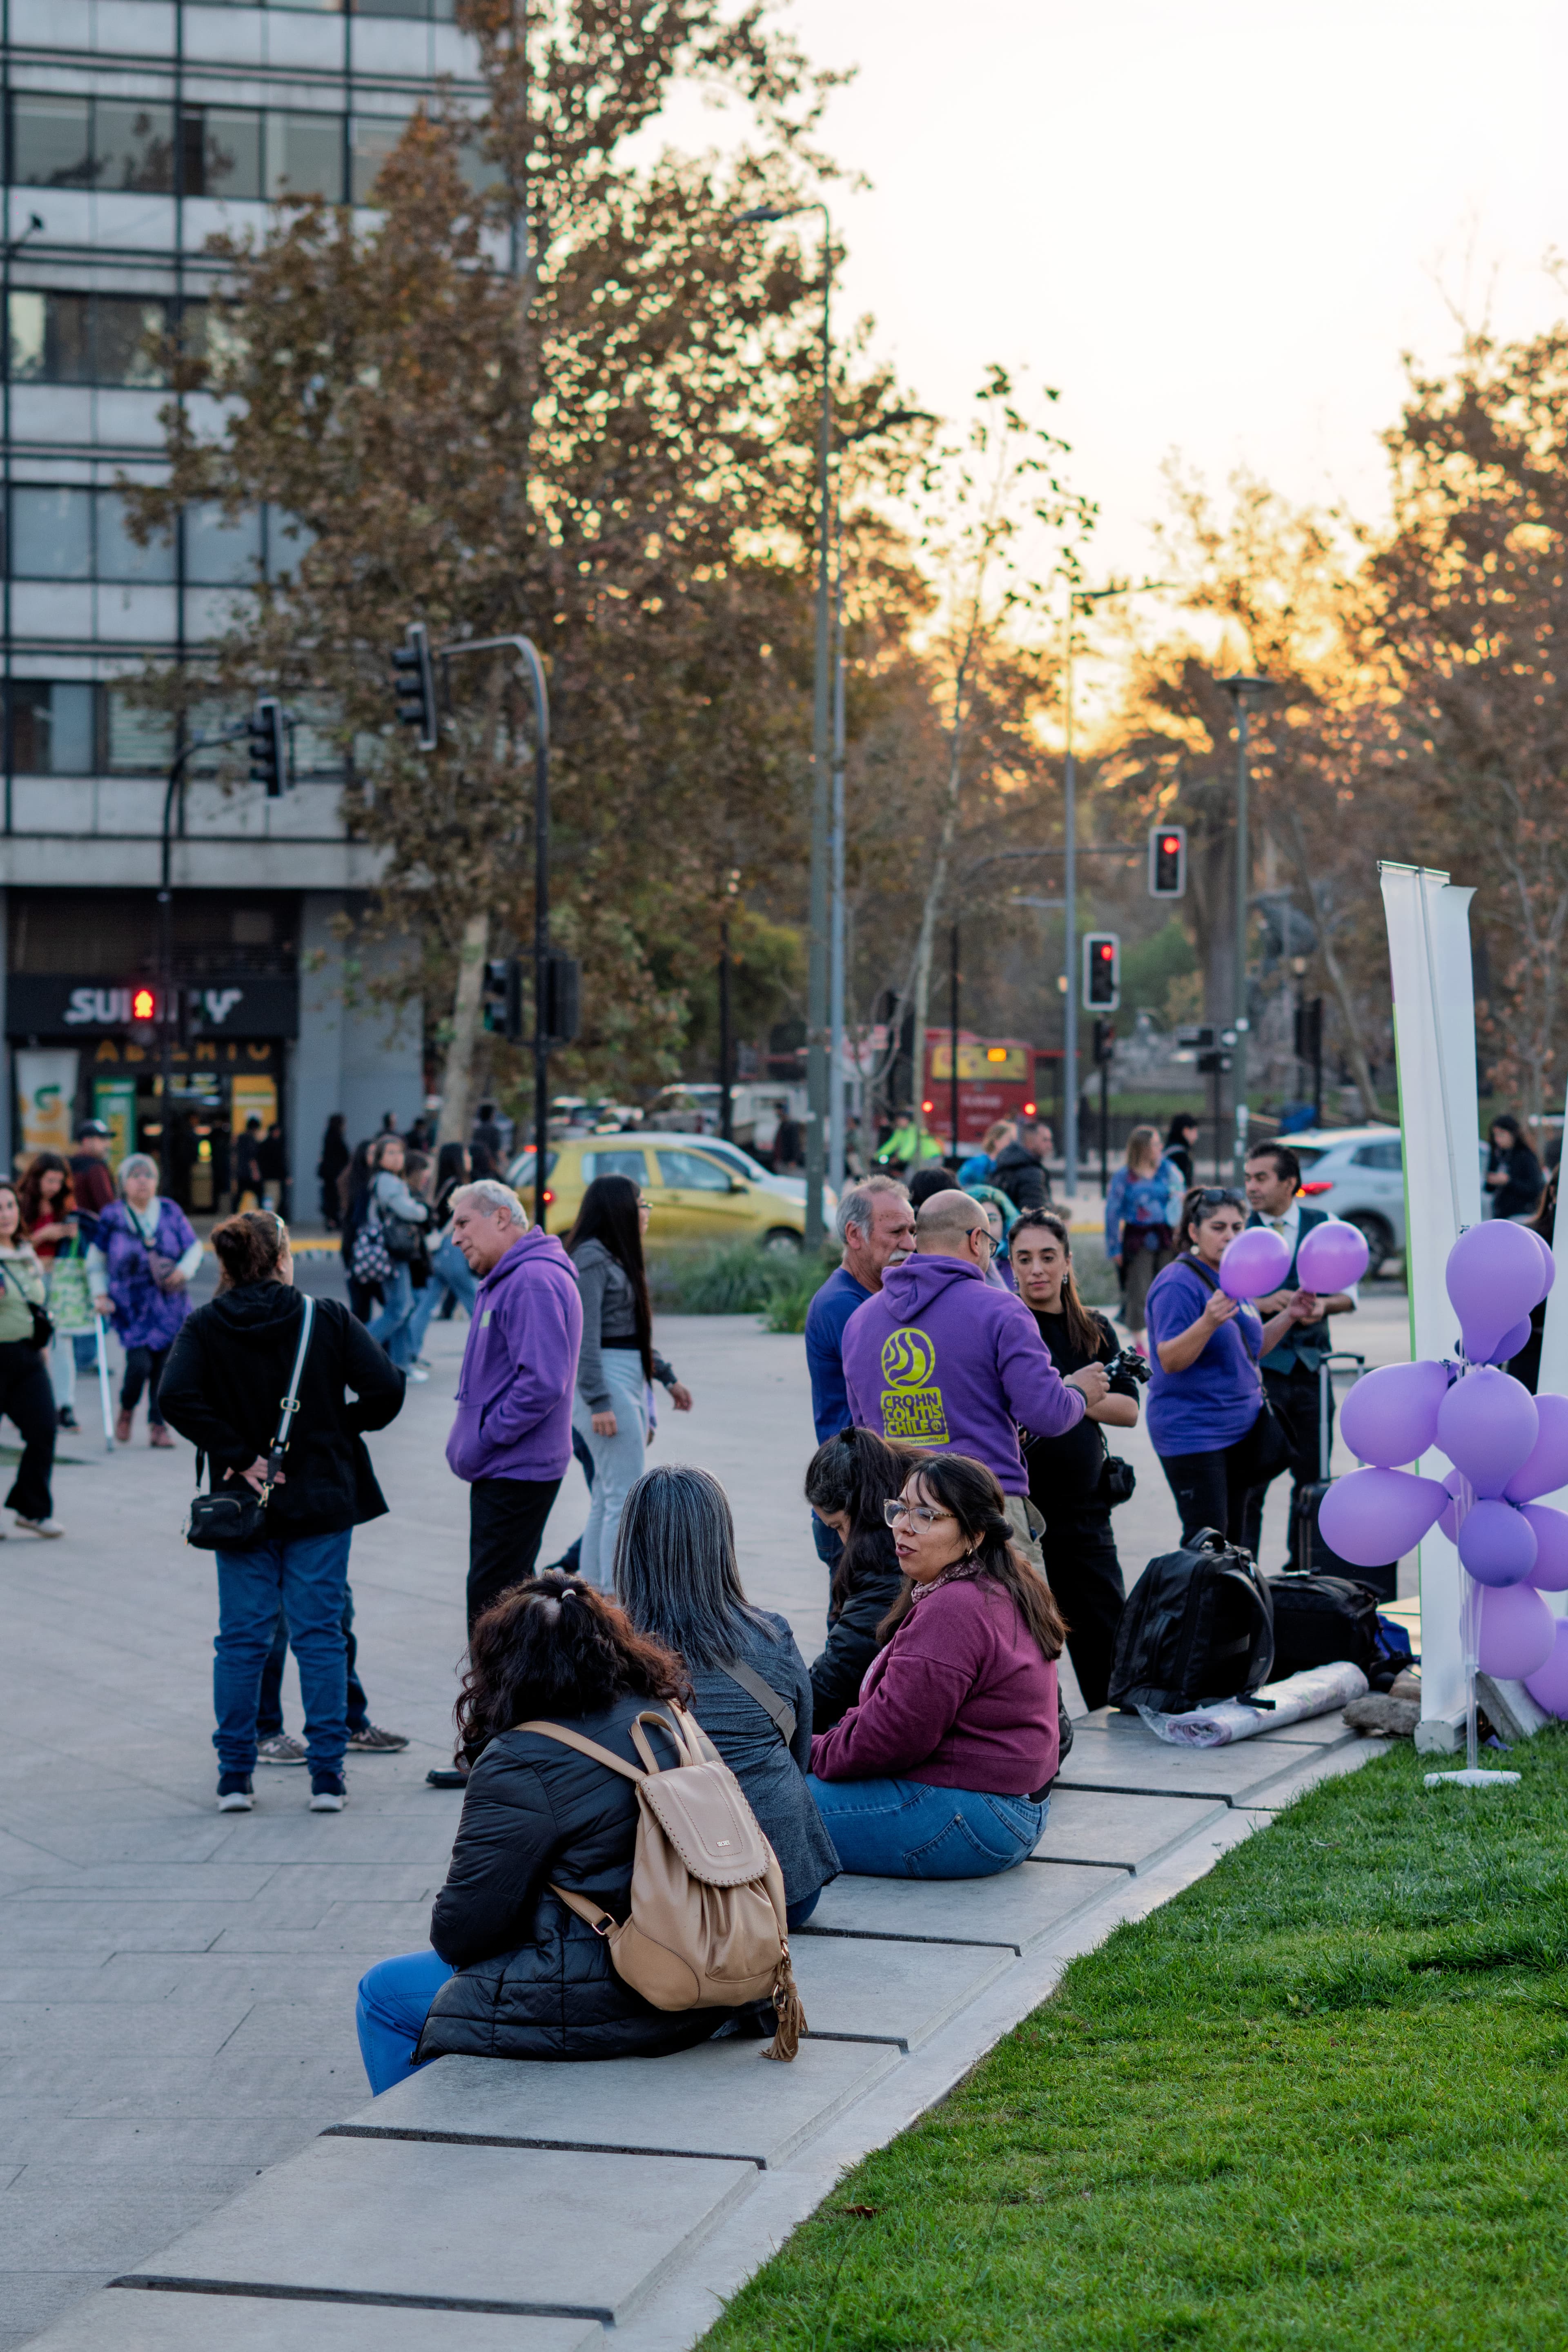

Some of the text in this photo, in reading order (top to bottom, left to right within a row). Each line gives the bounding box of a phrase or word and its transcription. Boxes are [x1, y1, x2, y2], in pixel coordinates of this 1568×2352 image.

[884, 1392, 938, 1410] CROHN
[885, 1405, 942, 1422] COLITIS
[887, 1420, 931, 1435] CHILE
